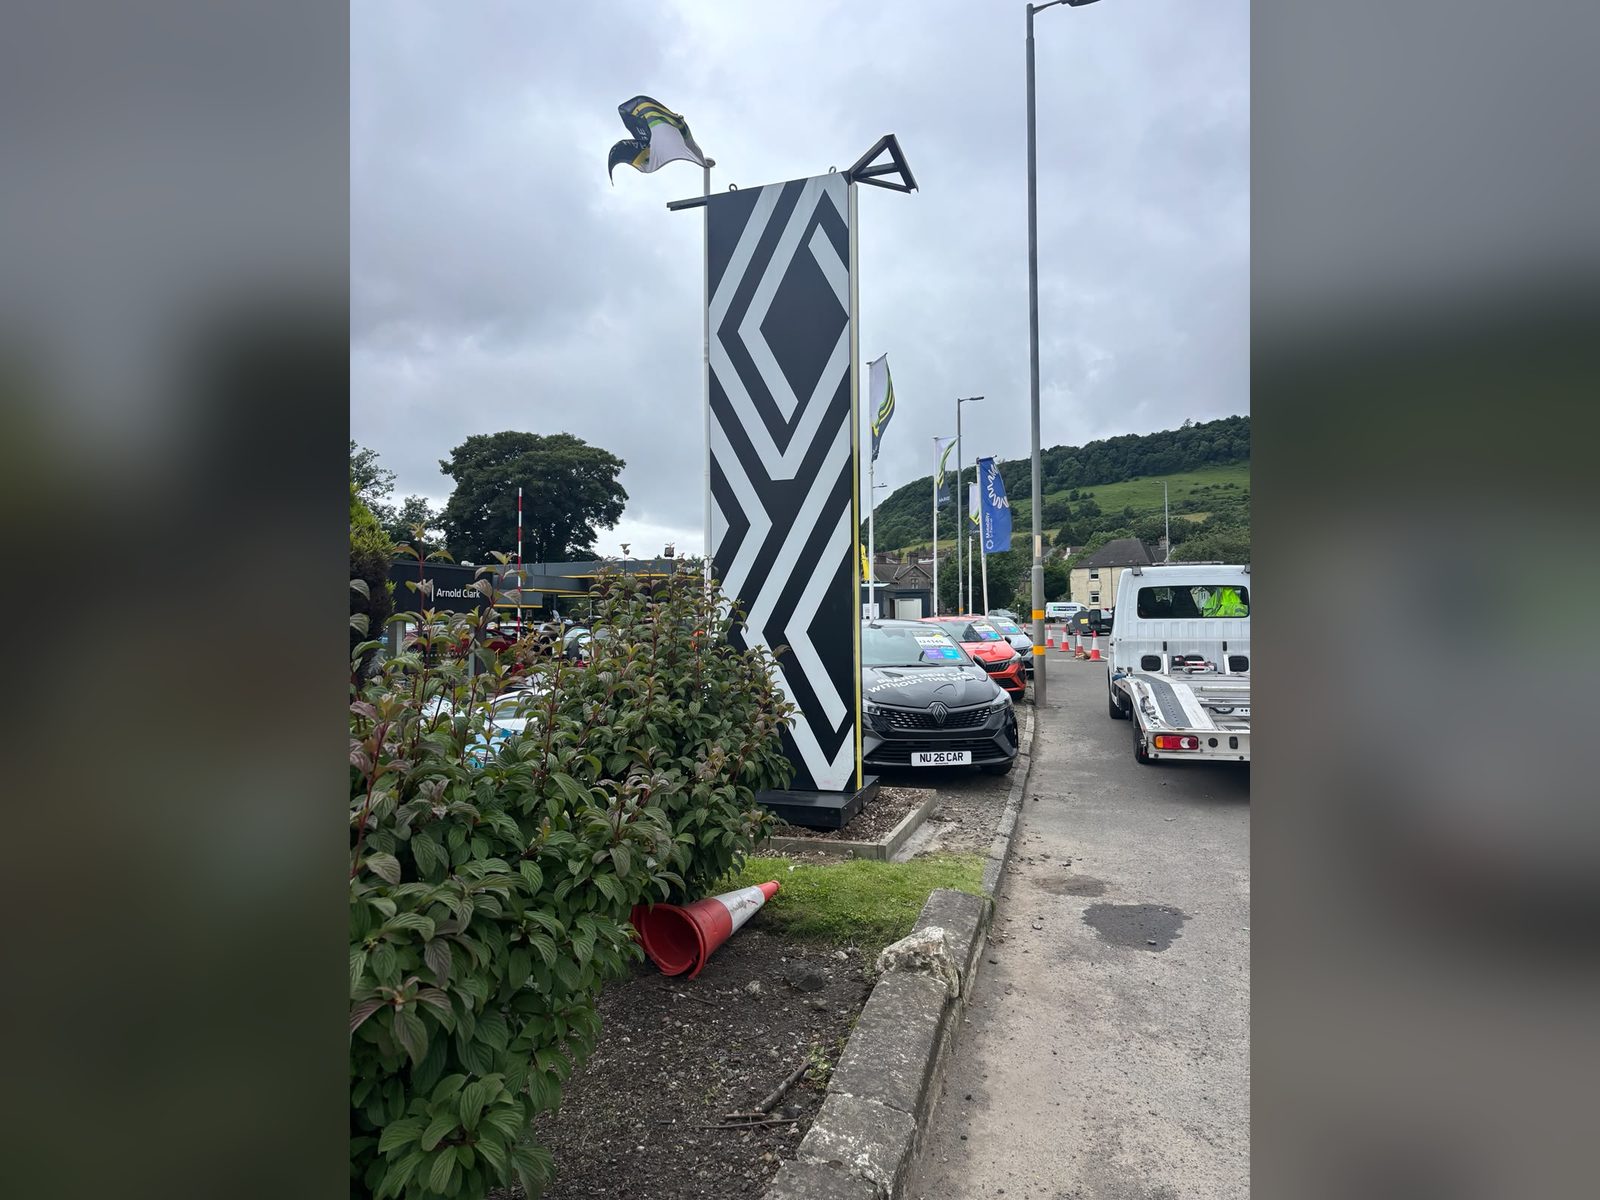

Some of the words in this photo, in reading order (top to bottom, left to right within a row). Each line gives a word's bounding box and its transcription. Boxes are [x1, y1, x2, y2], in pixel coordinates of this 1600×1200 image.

[436, 588, 461, 598] Arnold
[462, 589, 480, 598] Clark
[869, 678, 923, 693] WITHOUT
[919, 753, 932, 763] NU
[933, 752, 945, 762] 26
[946, 752, 964, 762] CAR
